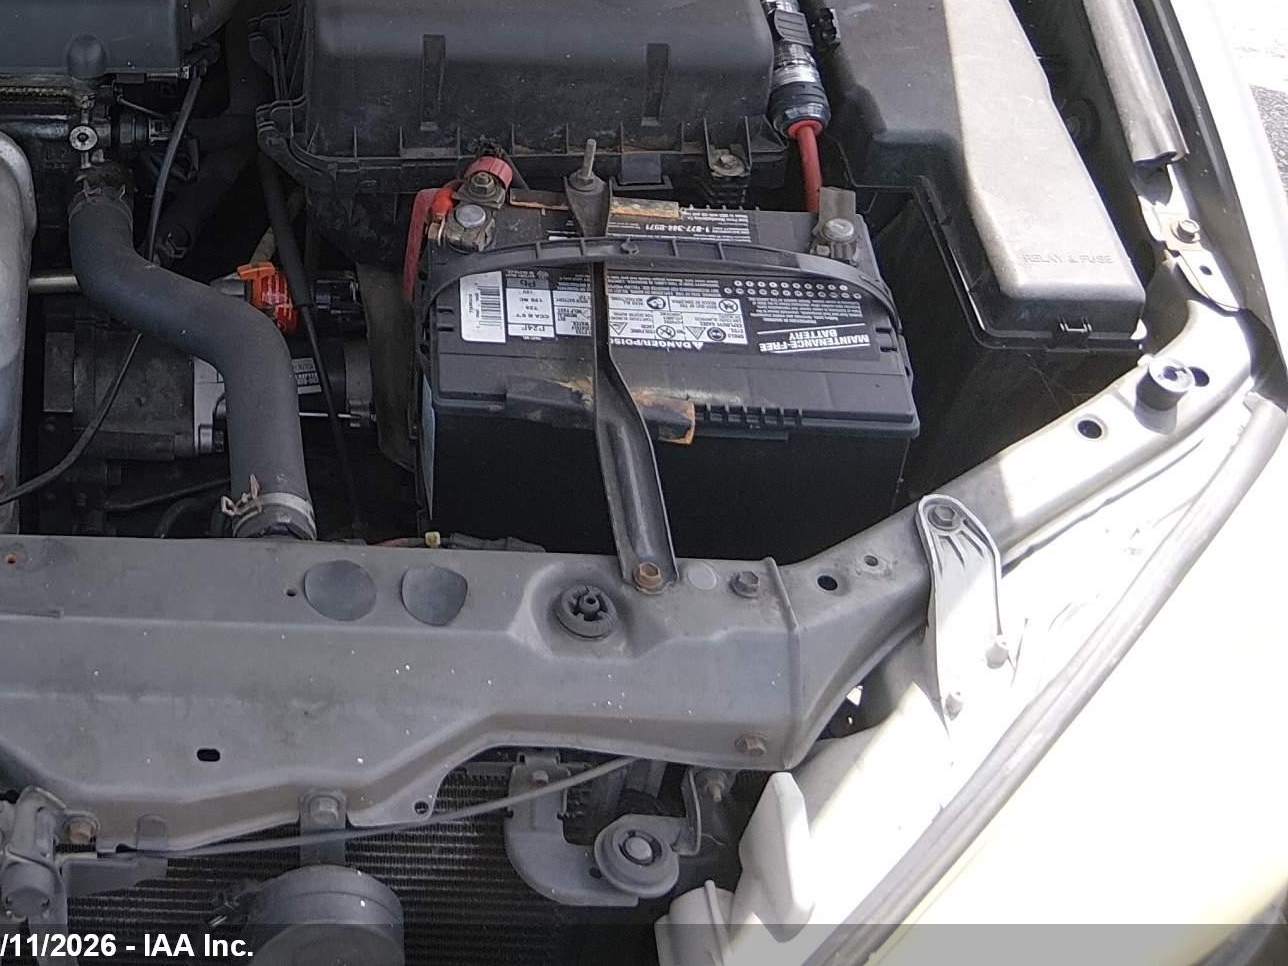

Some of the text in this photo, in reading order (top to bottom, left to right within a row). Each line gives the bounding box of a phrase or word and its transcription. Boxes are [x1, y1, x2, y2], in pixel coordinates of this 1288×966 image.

[1023, 254, 1114, 264] RELAY & FUSE
[520, 280, 536, 288] Pb
[788, 328, 837, 341] BATTERY
[759, 334, 870, 352] MAINTENANCE-FREE
